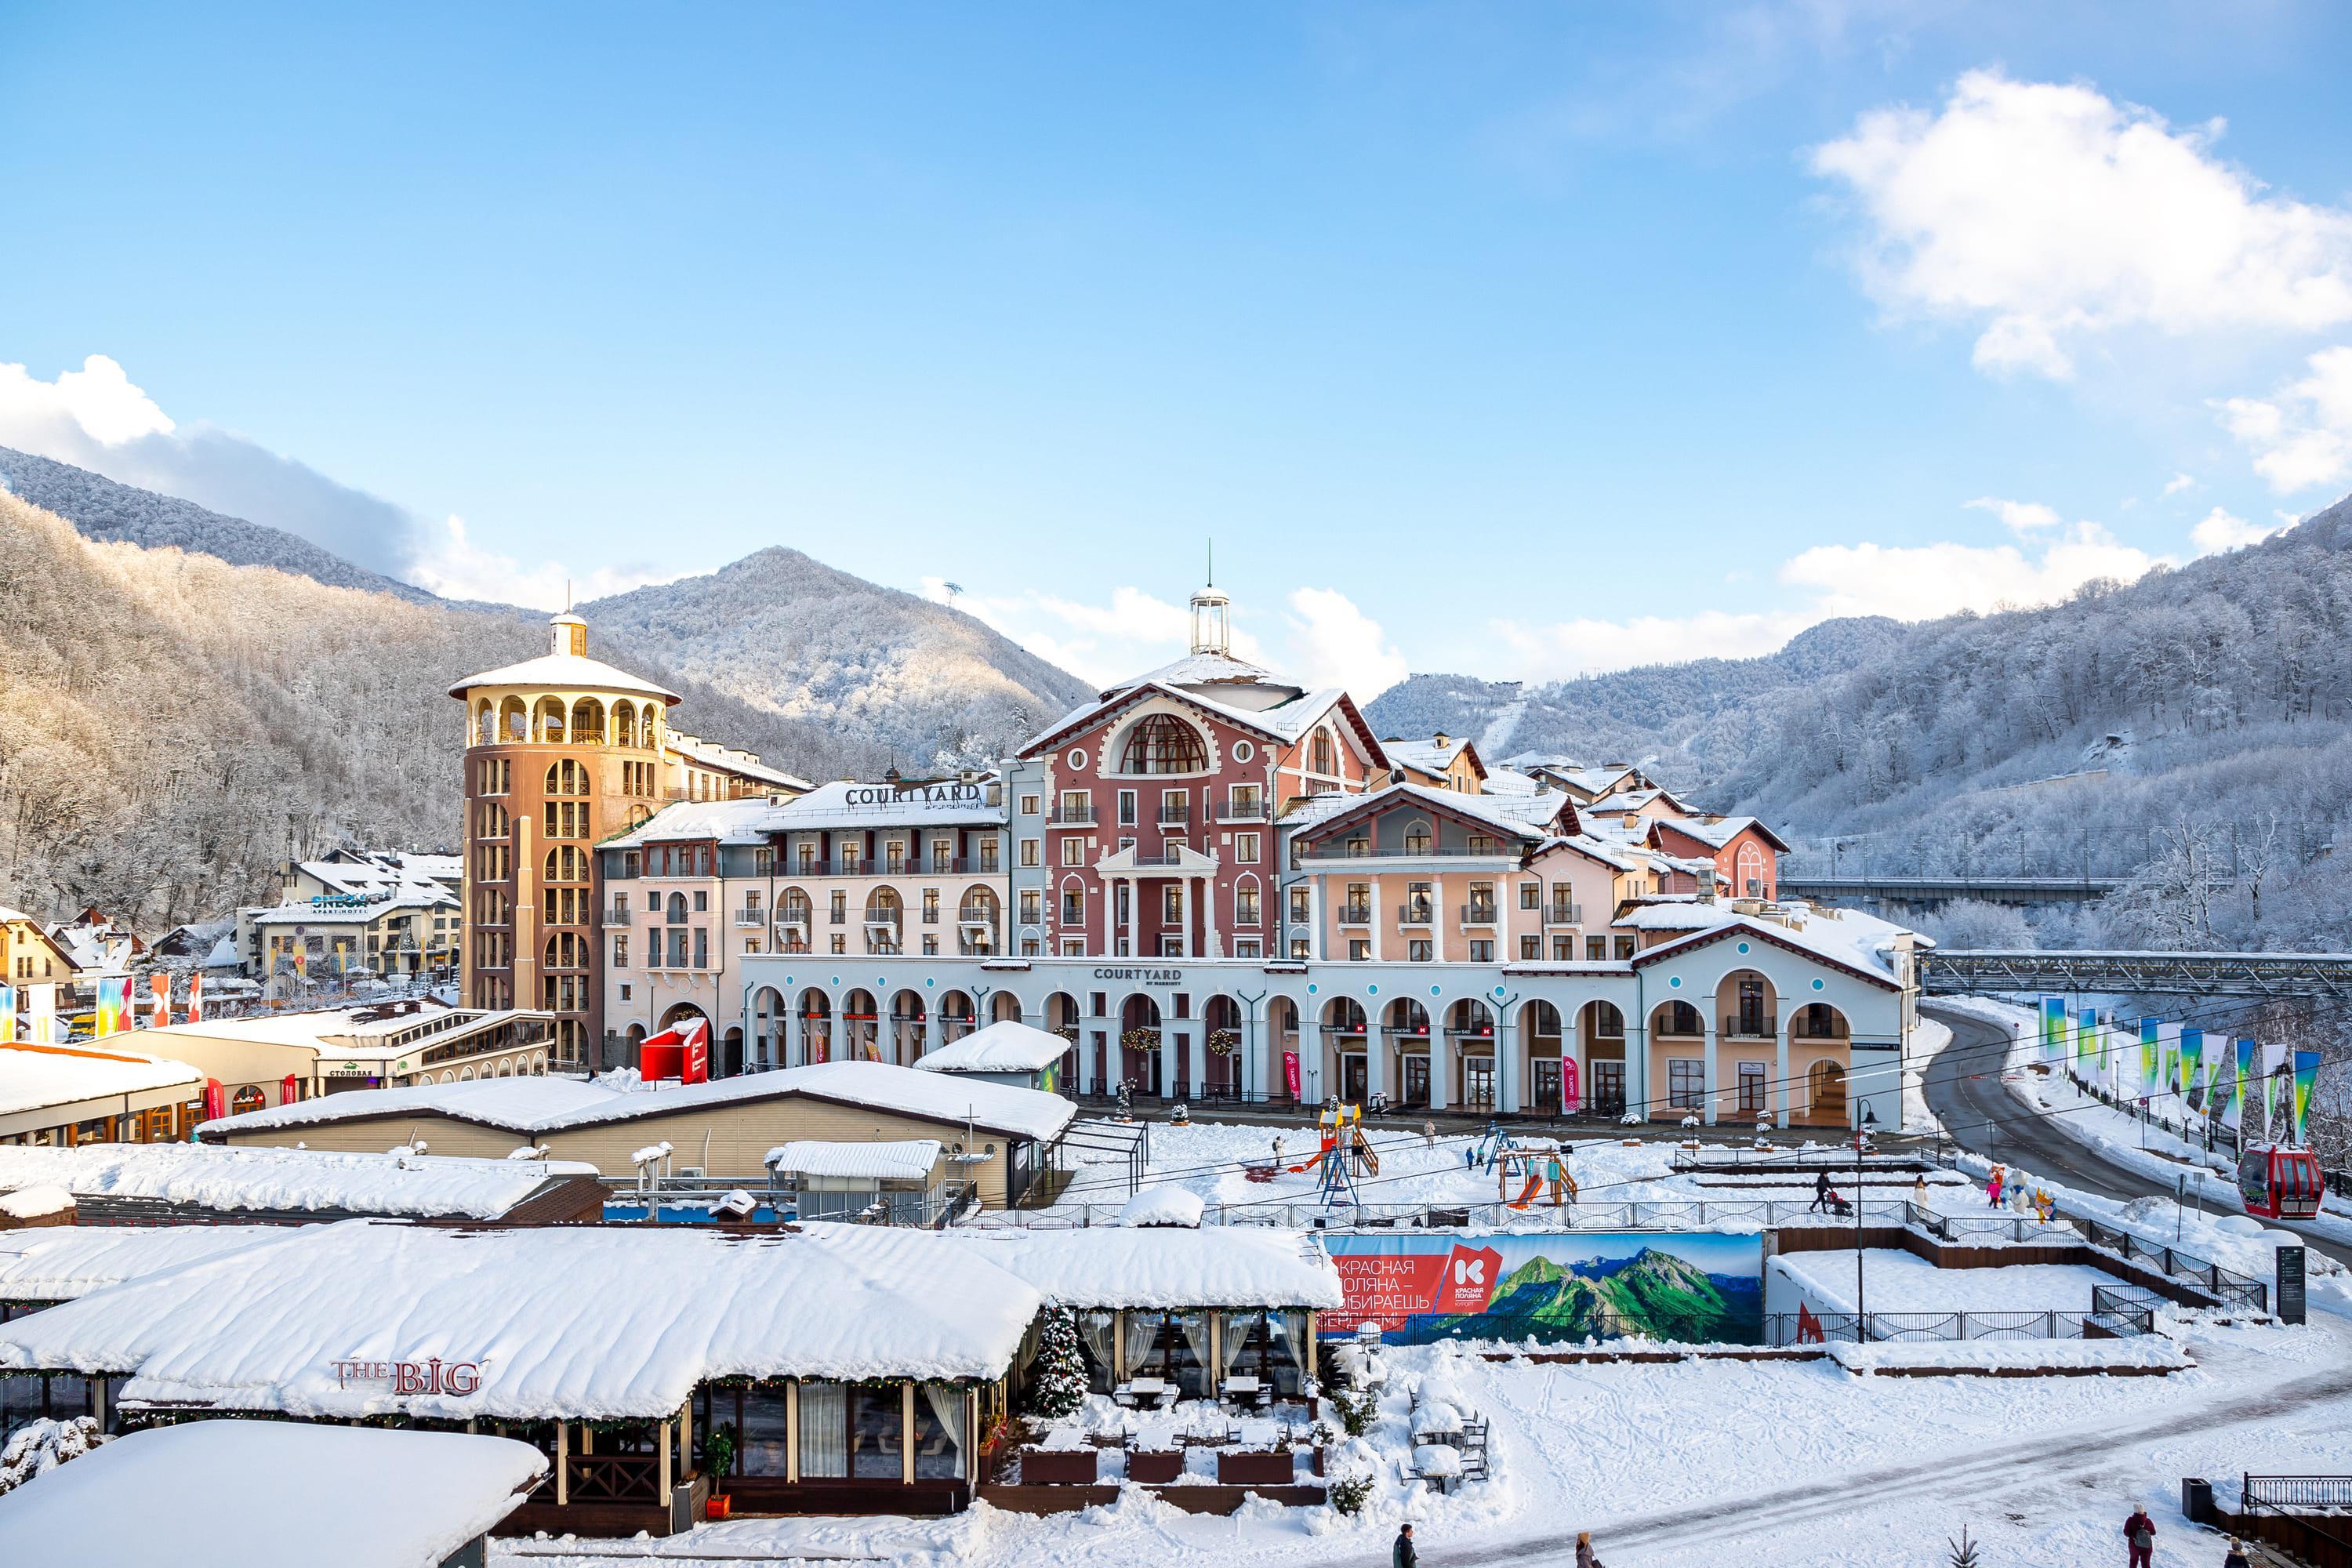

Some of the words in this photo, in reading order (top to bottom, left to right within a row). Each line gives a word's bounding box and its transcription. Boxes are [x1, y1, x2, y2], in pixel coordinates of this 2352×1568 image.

[845, 784, 979, 805] COURTYARD
[1094, 967, 1181, 980] COURTYARD
[1339, 1260, 1414, 1275] КРАСНАЯ
[330, 1362, 389, 1378] THE
[394, 1360, 481, 1395] BIG
